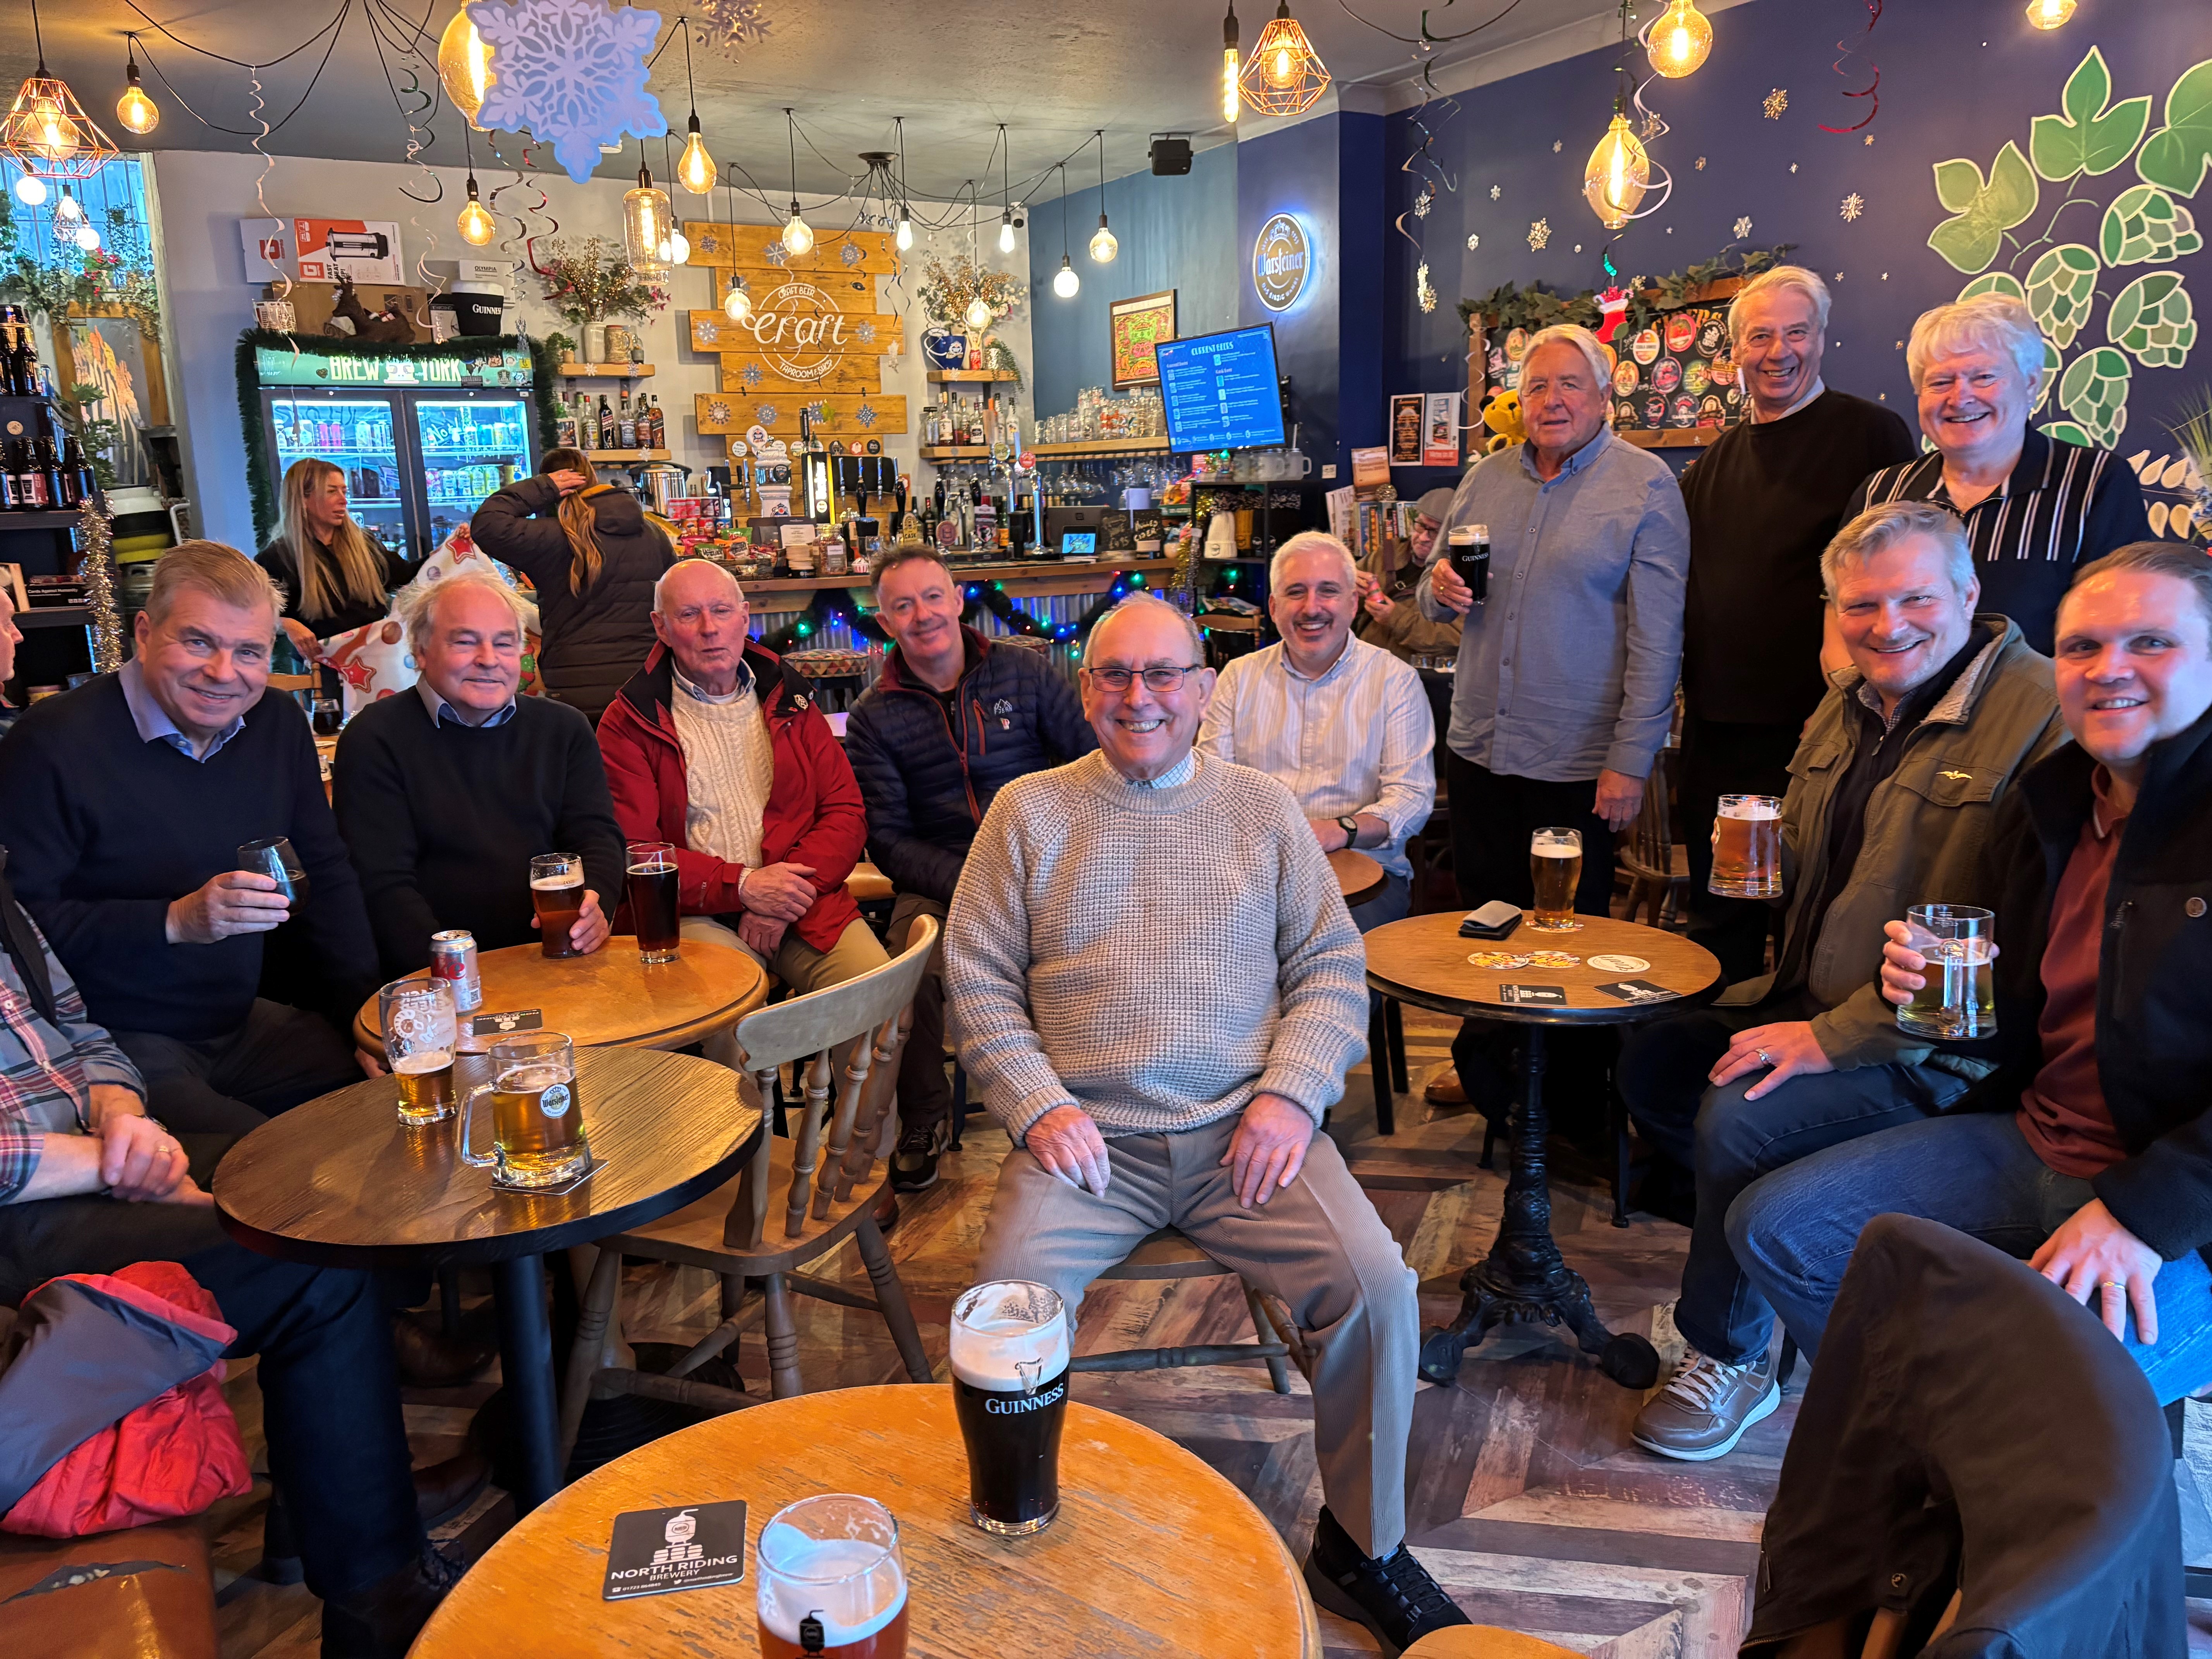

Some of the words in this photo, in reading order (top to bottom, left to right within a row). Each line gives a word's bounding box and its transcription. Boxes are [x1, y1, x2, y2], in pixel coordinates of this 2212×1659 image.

[1257, 247, 1304, 276] Warsteiner
[778, 287, 798, 299] CRAFT
[799, 287, 815, 297] BEER
[741, 312, 848, 345] Craft
[1191, 344, 1216, 356] CURRENT
[1216, 341, 1234, 352] BEERS
[329, 356, 379, 381] BREW
[422, 357, 462, 382] YORK
[779, 362, 814, 378] TAPROOM
[1462, 552, 1489, 562] GUINNESS
[542, 1094, 569, 1108] Warsteiner
[985, 1382, 1064, 1415] GUINNESS
[611, 1563, 673, 1580] NORTH
[677, 1555, 738, 1570] RIDING
[649, 1569, 700, 1581] BREWERY
